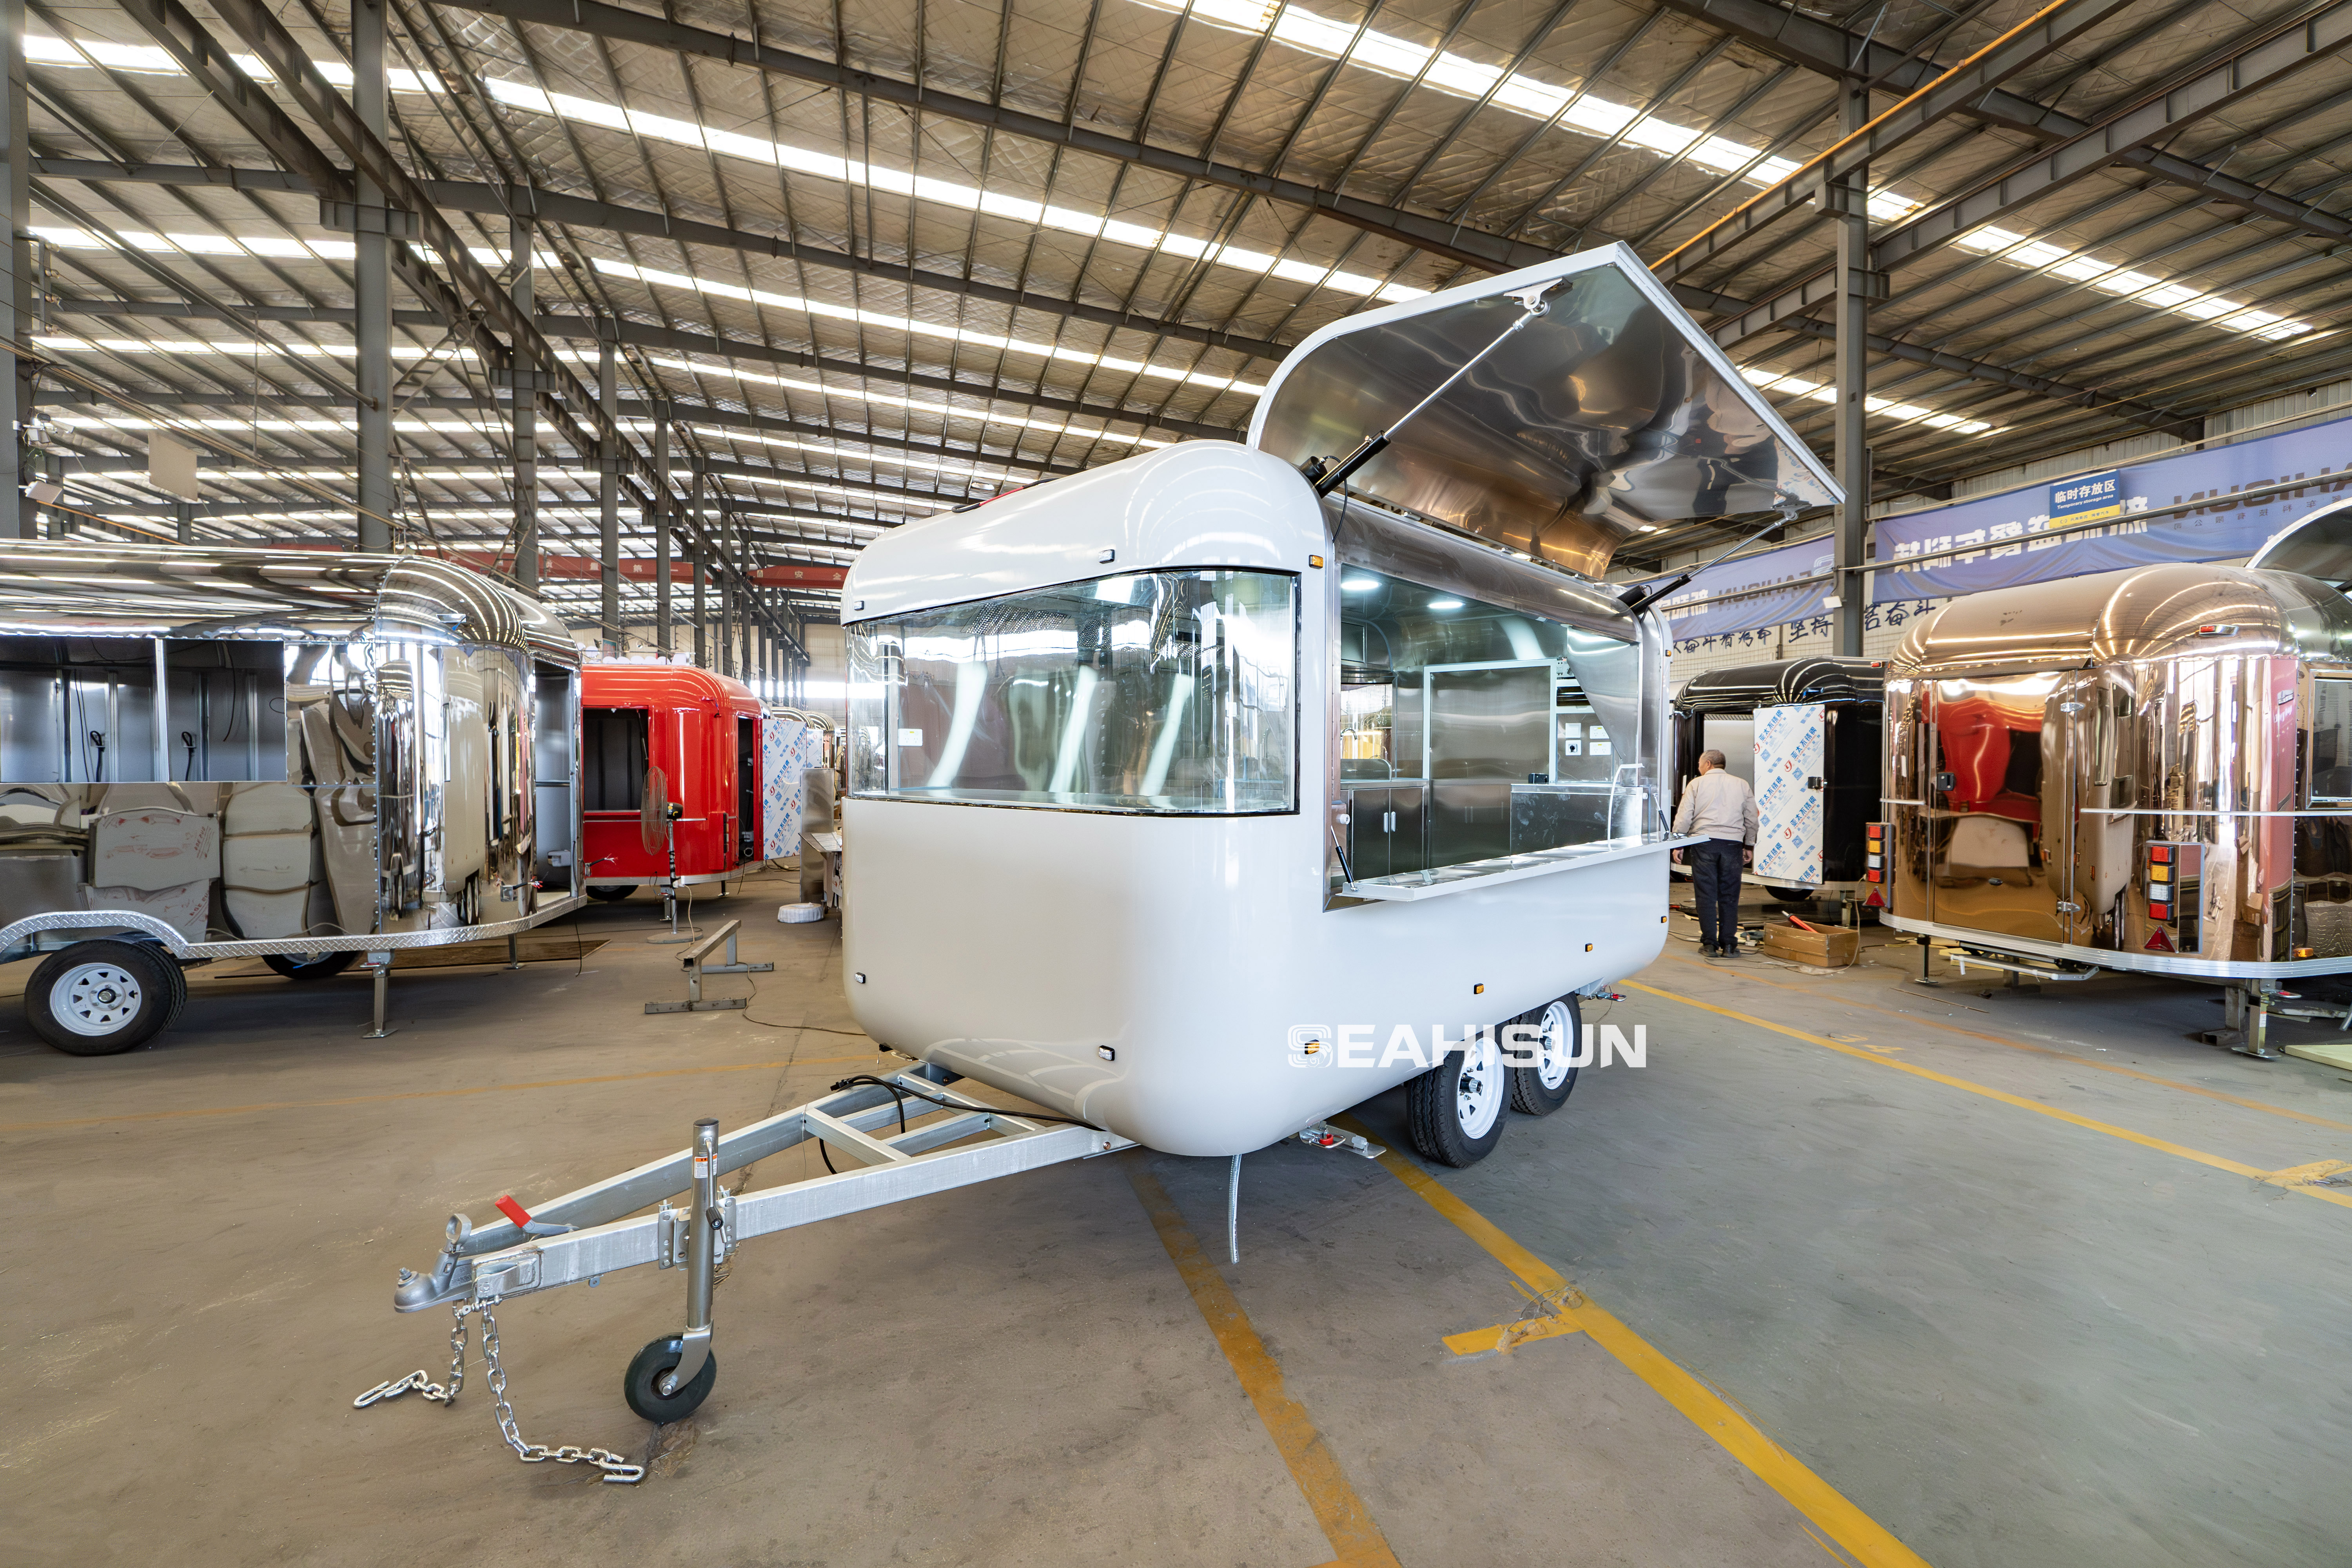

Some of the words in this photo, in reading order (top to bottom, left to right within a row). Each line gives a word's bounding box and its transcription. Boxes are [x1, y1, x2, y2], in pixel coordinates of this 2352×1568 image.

[2055, 479, 2116, 503] 临时存放区
[2057, 501, 2083, 509] Temporary
[1759, 710, 1783, 741] 亚太不锈钢
[1790, 726, 1817, 759] 亚太不锈钢
[1759, 776, 1783, 807] 亚太不锈钢
[1790, 795, 1817, 827] 亚太不锈钢
[1758, 842, 1782, 871] 亚太不锈钢
